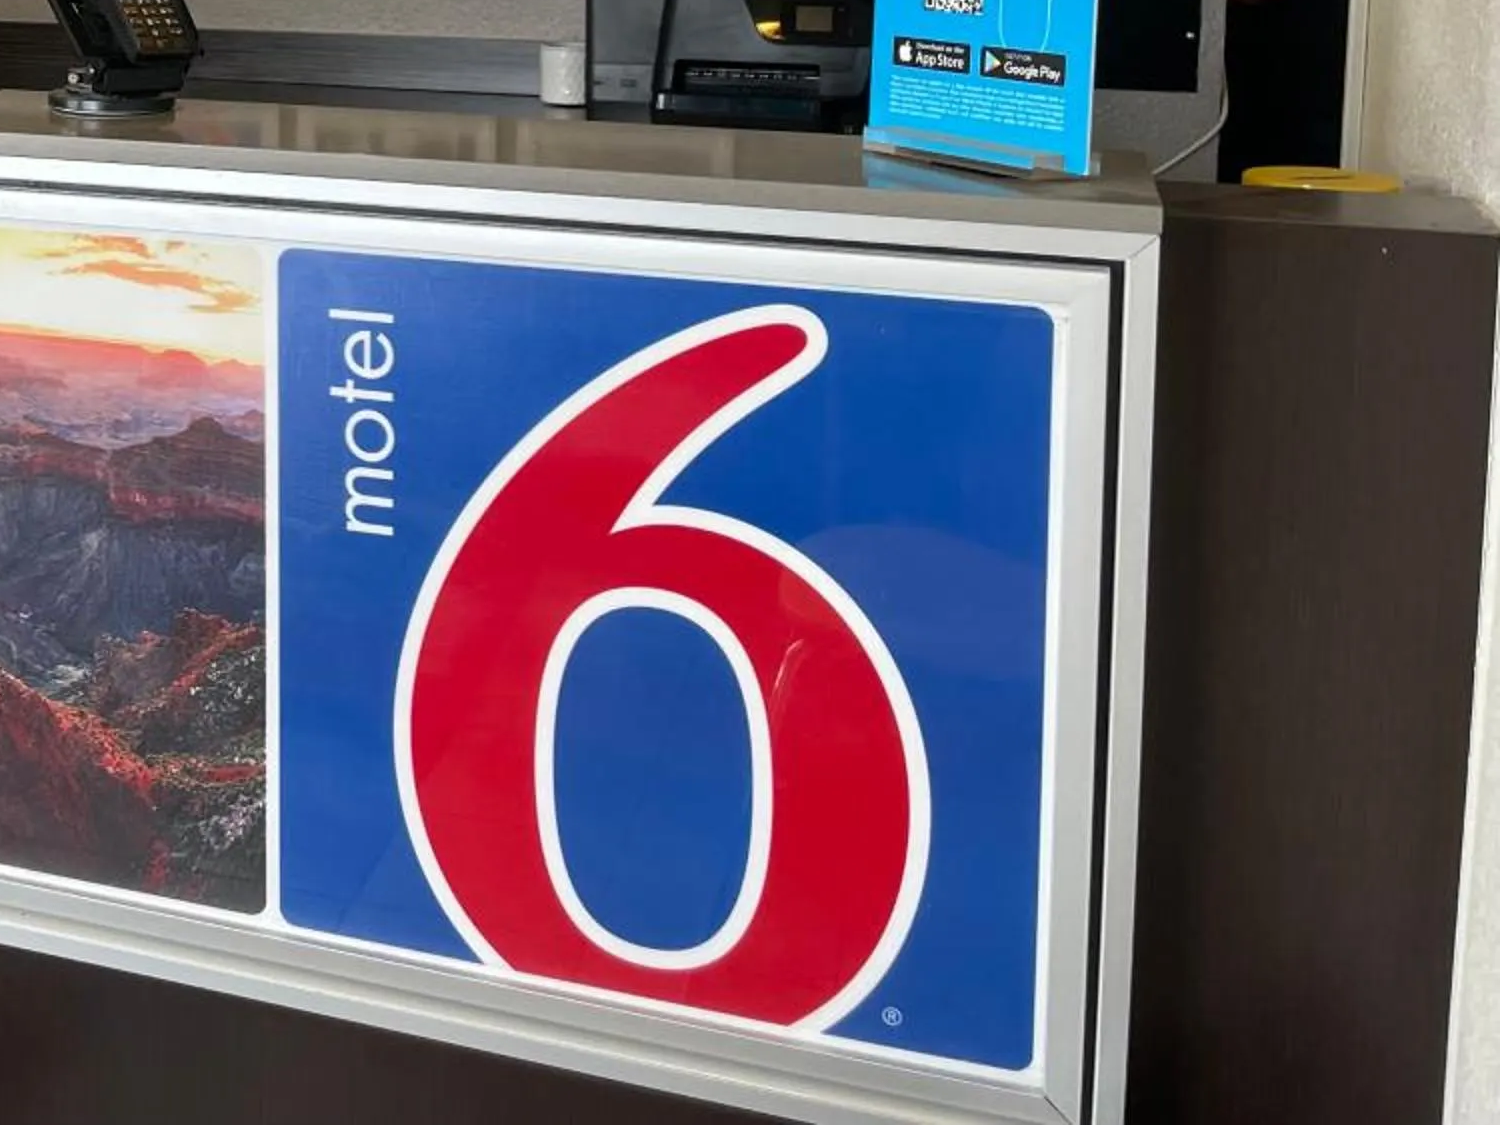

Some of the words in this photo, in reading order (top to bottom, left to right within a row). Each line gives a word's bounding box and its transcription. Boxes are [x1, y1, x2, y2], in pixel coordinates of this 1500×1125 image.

[915, 51, 937, 68] App
[937, 52, 965, 70] Store
[1003, 60, 1039, 80] Google
[1039, 64, 1061, 84] Play
[329, 308, 394, 536] motel
[393, 304, 932, 1036] 6
